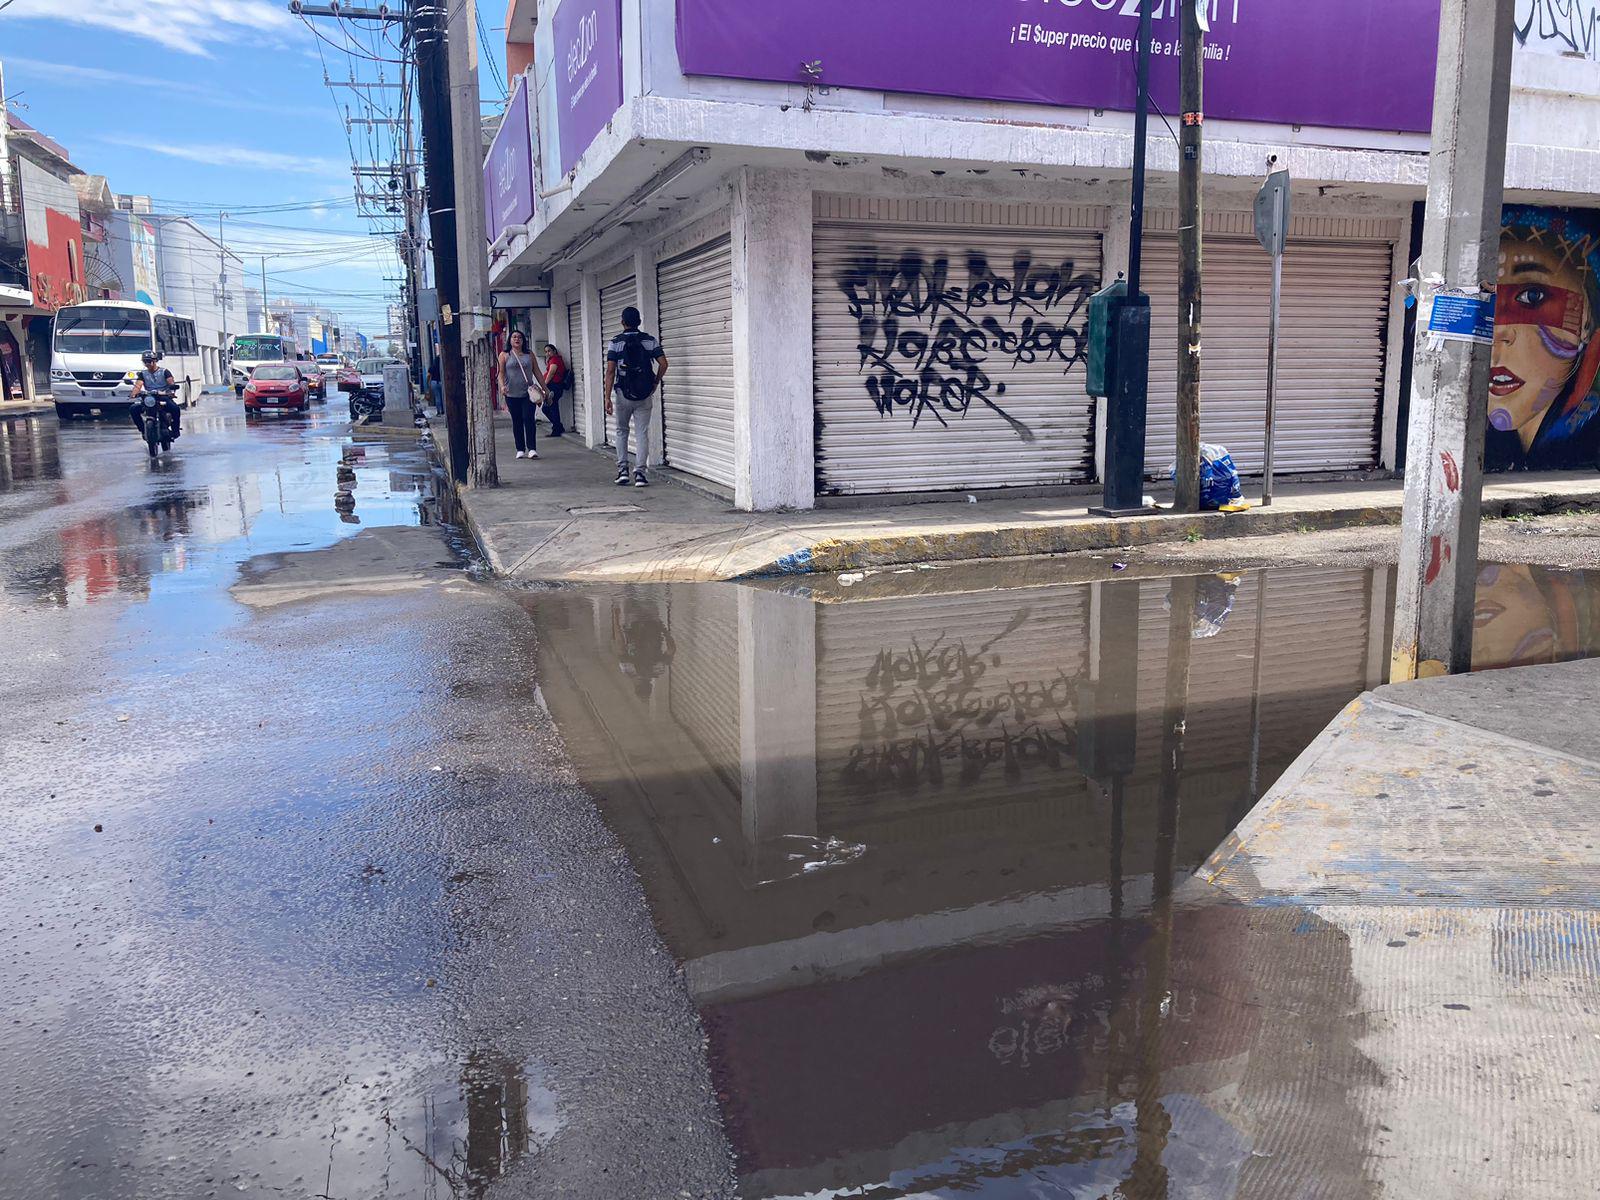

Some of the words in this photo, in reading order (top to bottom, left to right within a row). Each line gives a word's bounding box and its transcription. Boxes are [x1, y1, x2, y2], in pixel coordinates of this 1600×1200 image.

[1018, 23, 1032, 42] El
[1069, 31, 1107, 50] precio
[1109, 36, 1132, 54] que
[1163, 41, 1172, 56] a
